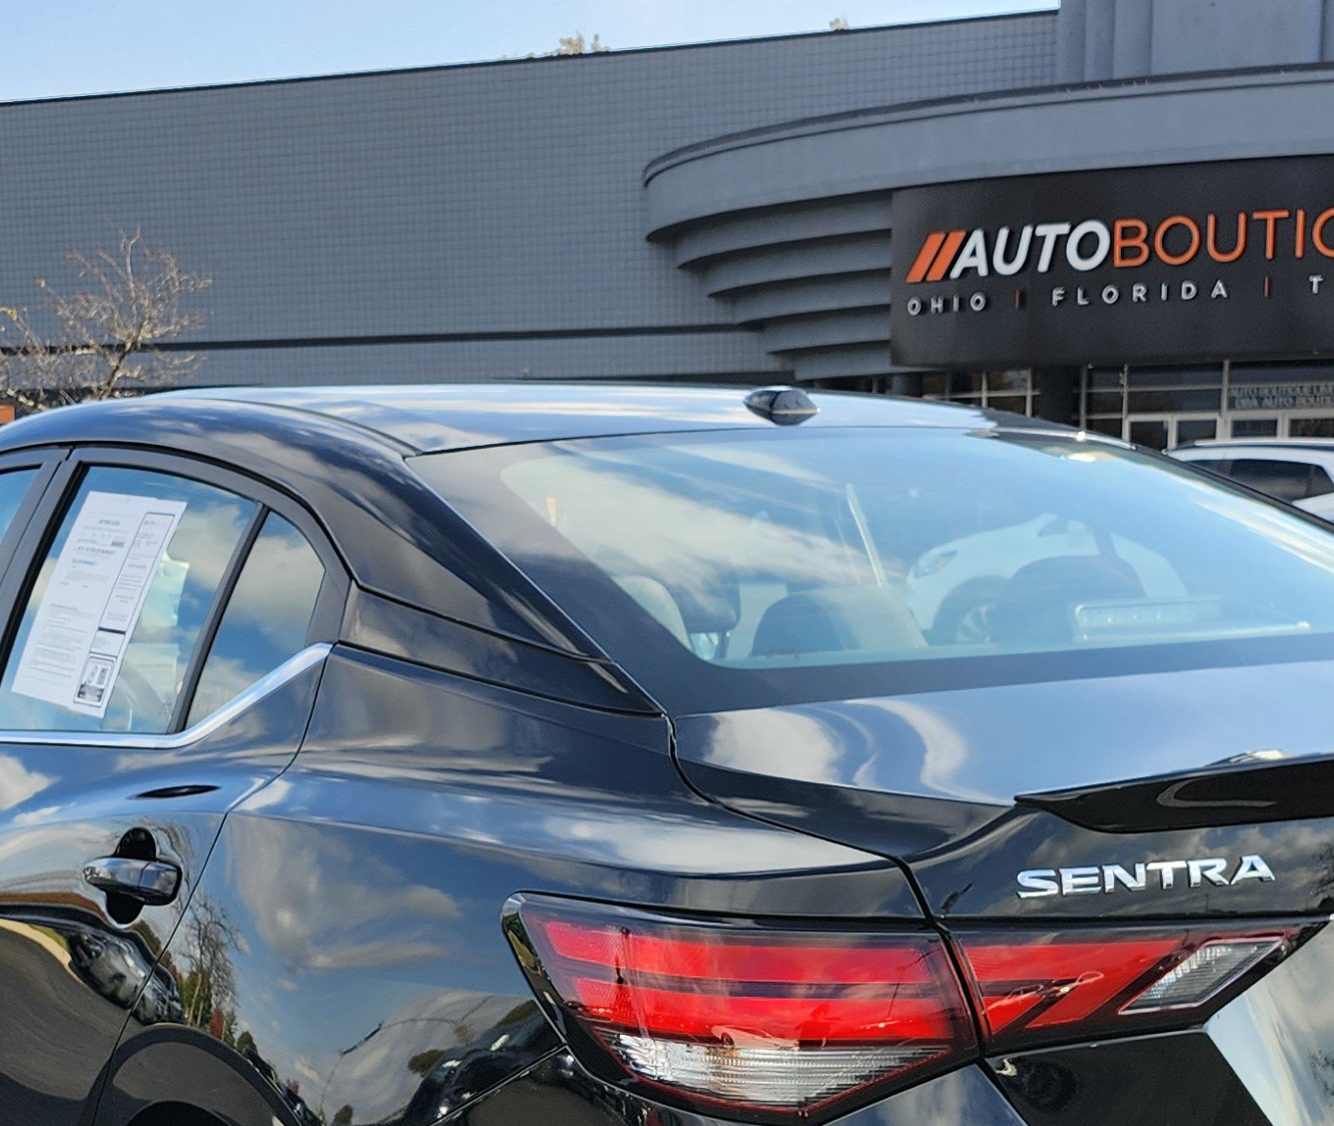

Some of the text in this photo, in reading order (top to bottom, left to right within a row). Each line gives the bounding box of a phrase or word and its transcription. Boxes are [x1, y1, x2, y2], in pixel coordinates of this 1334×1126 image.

[906, 291, 986, 316] OHIO
[1051, 278, 1229, 307] FLORIDA
[1017, 854, 1276, 899] SENTRA
